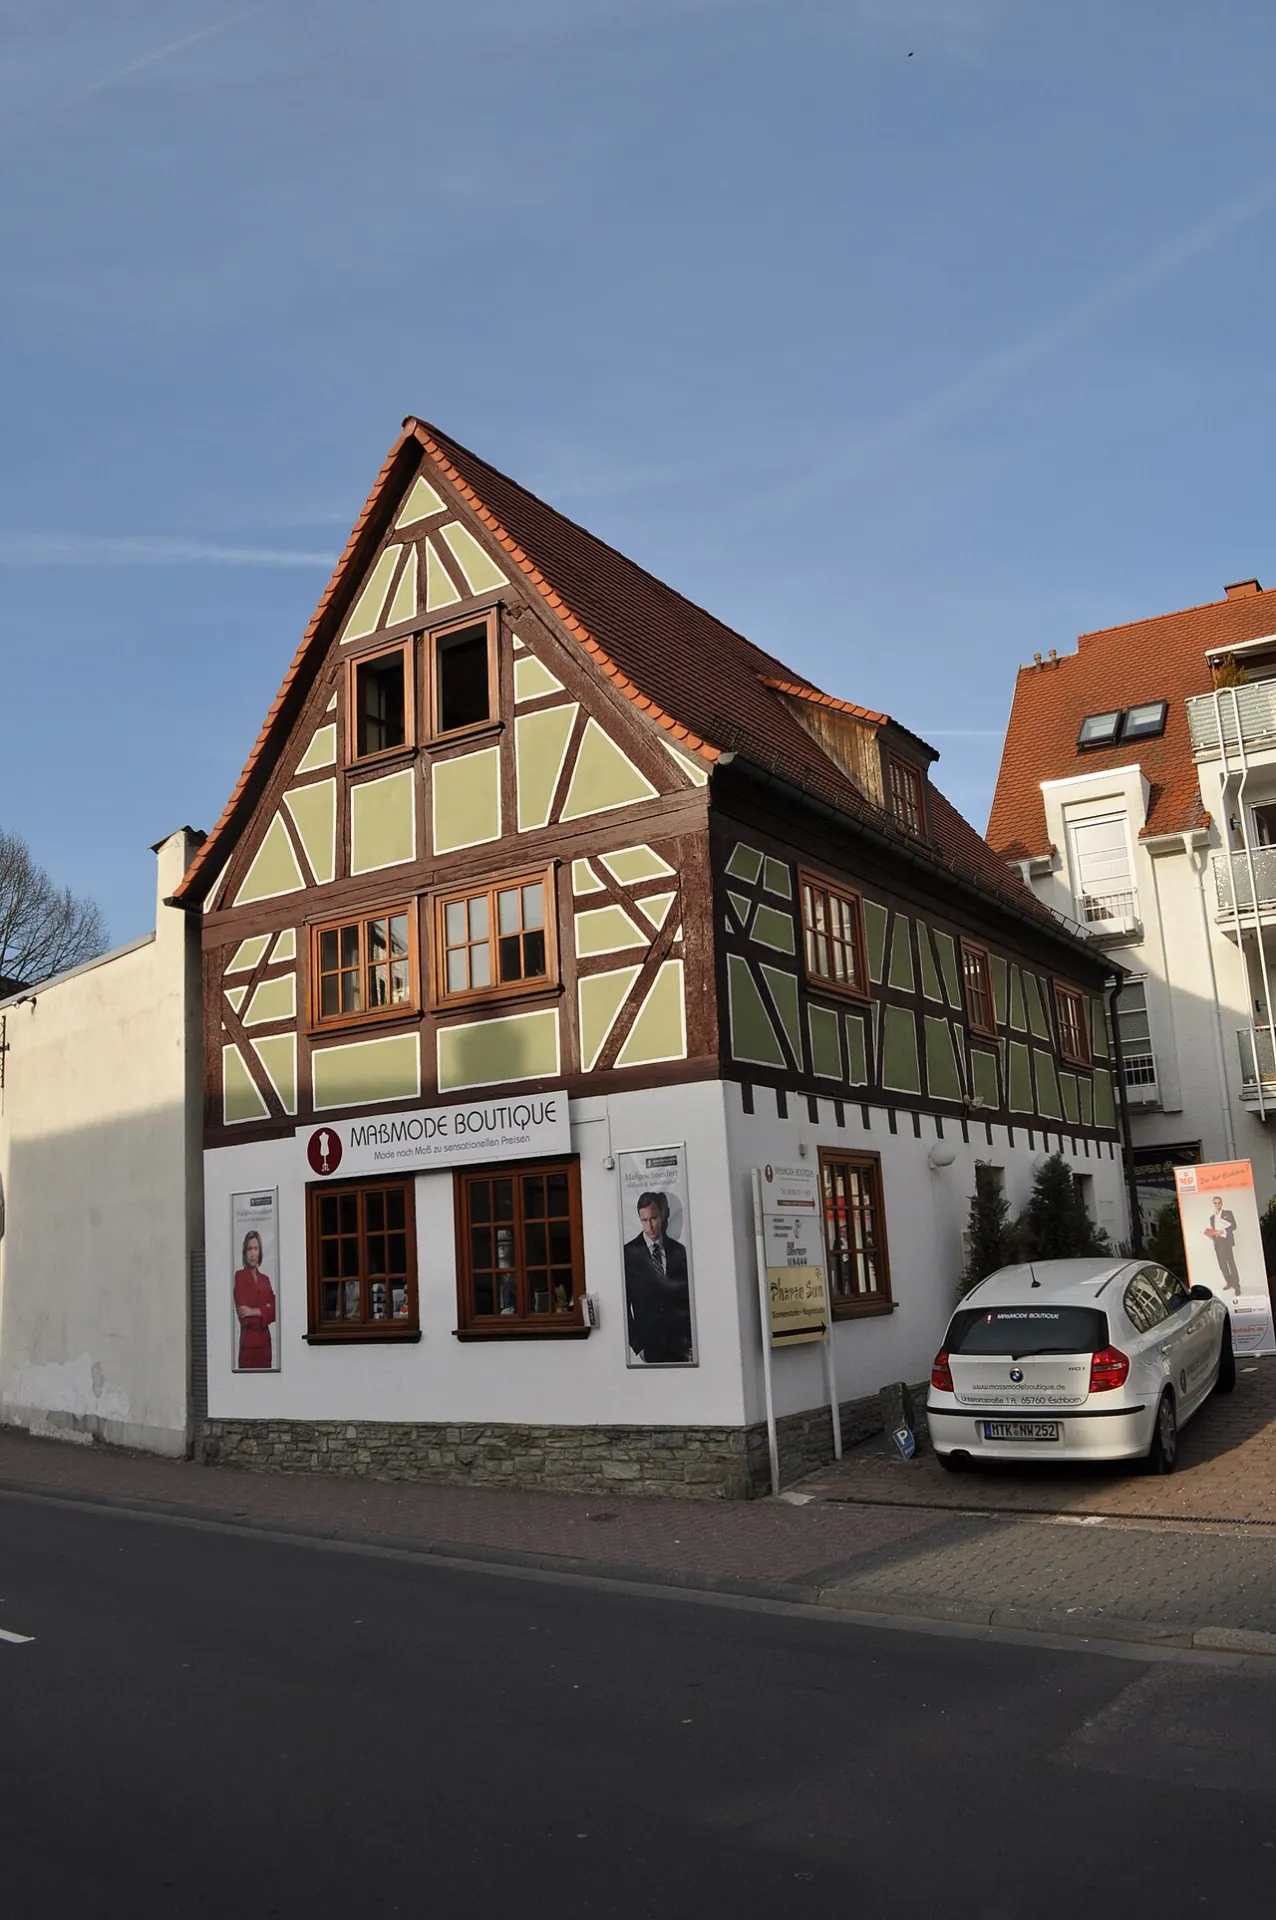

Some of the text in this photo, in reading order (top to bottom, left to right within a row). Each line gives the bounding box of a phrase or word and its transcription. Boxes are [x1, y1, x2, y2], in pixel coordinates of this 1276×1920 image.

[350, 1101, 557, 1147] MAßMODE BOUTIQUE
[374, 1134, 531, 1160] Mode nach Maß zu sensationellen Preisen
[770, 1277, 824, 1301] Pharao Sun
[972, 1383, 1066, 1391] www.massmodeboutique.de
[961, 1395, 1004, 1404] Unterortstraße
[1021, 1397, 1046, 1405] 65760
[1048, 1396, 1082, 1404] Eschborn
[896, 1430, 908, 1445] P
[991, 1424, 1013, 1437] MTK
